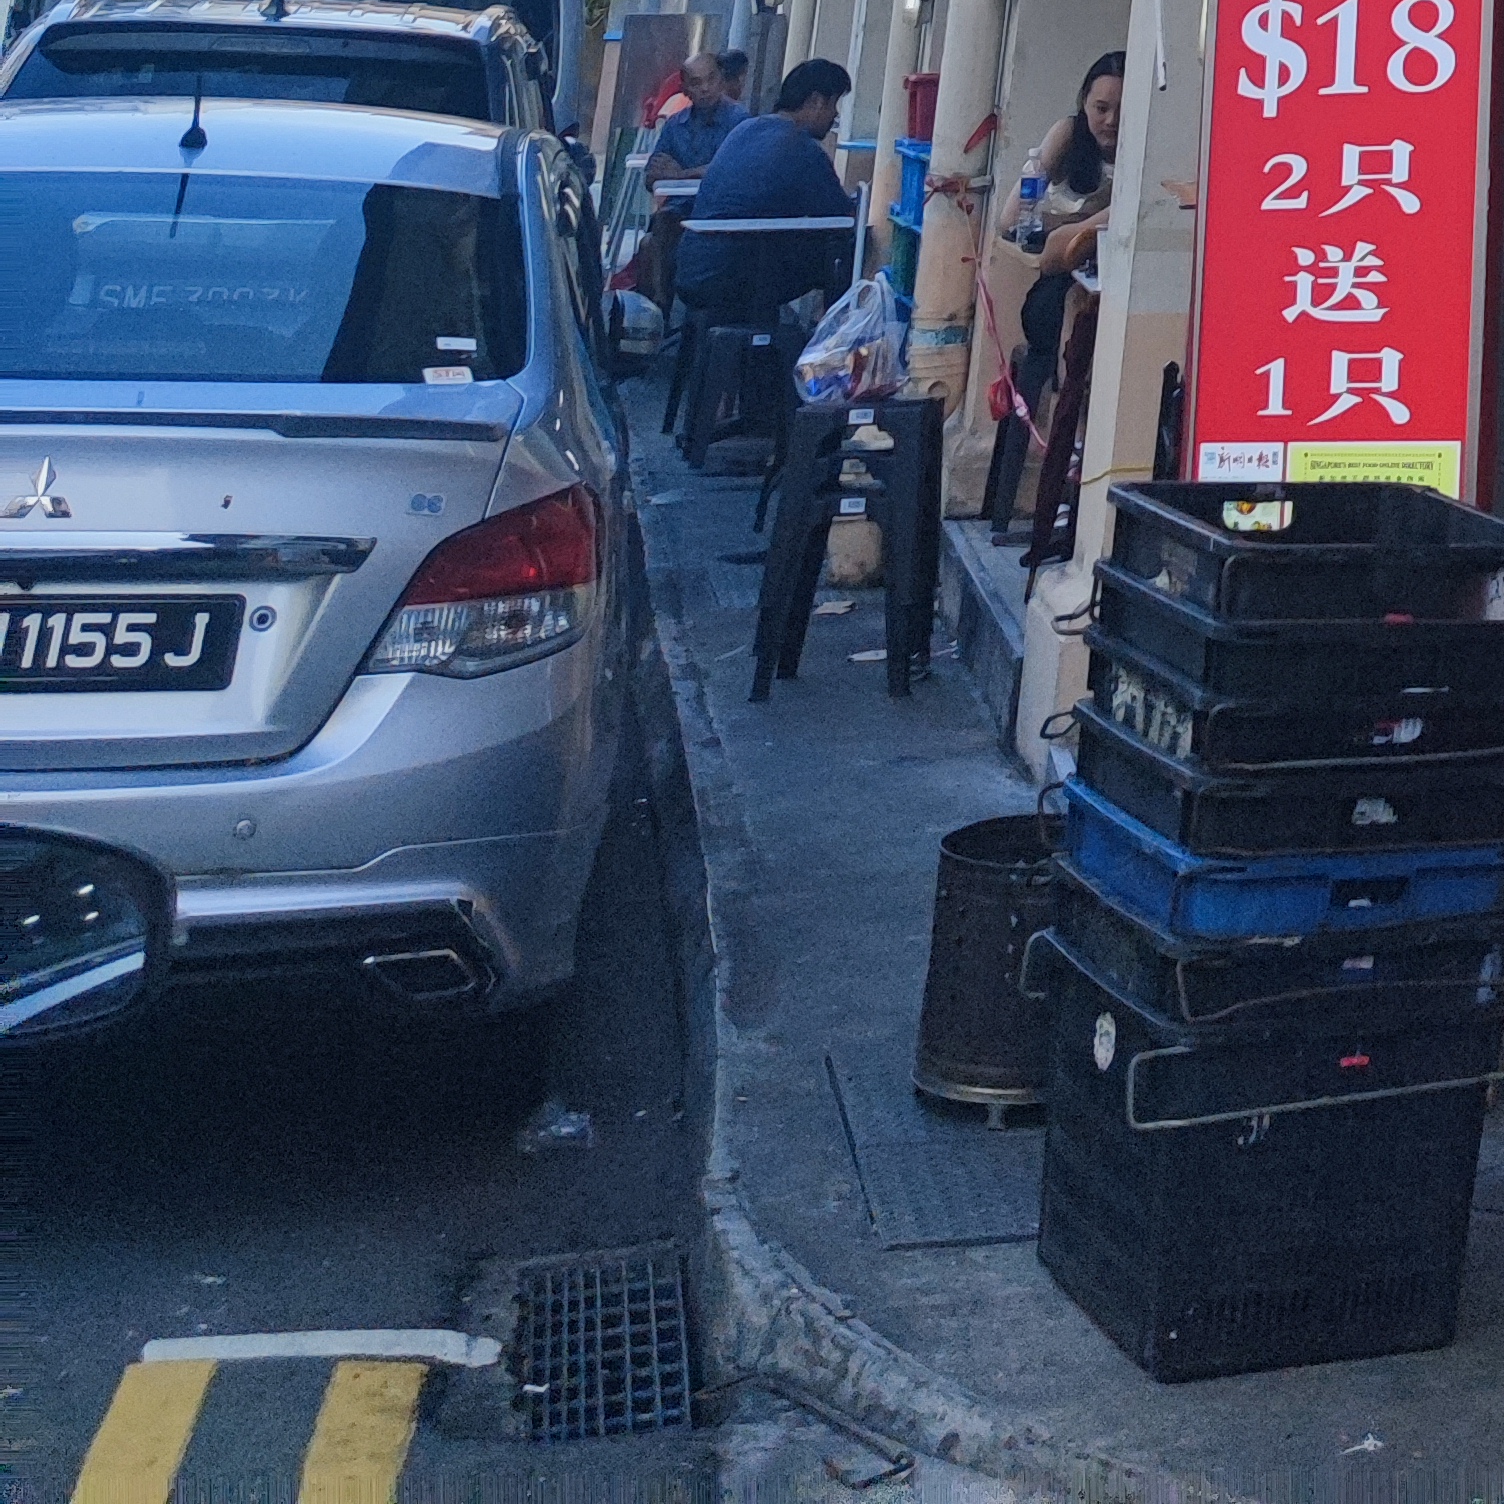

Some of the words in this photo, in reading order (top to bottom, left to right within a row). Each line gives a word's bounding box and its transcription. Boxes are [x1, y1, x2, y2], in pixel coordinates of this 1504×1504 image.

[1282, 242, 1391, 324] 送
[20, 612, 158, 669] 1155
[163, 612, 210, 668] J
